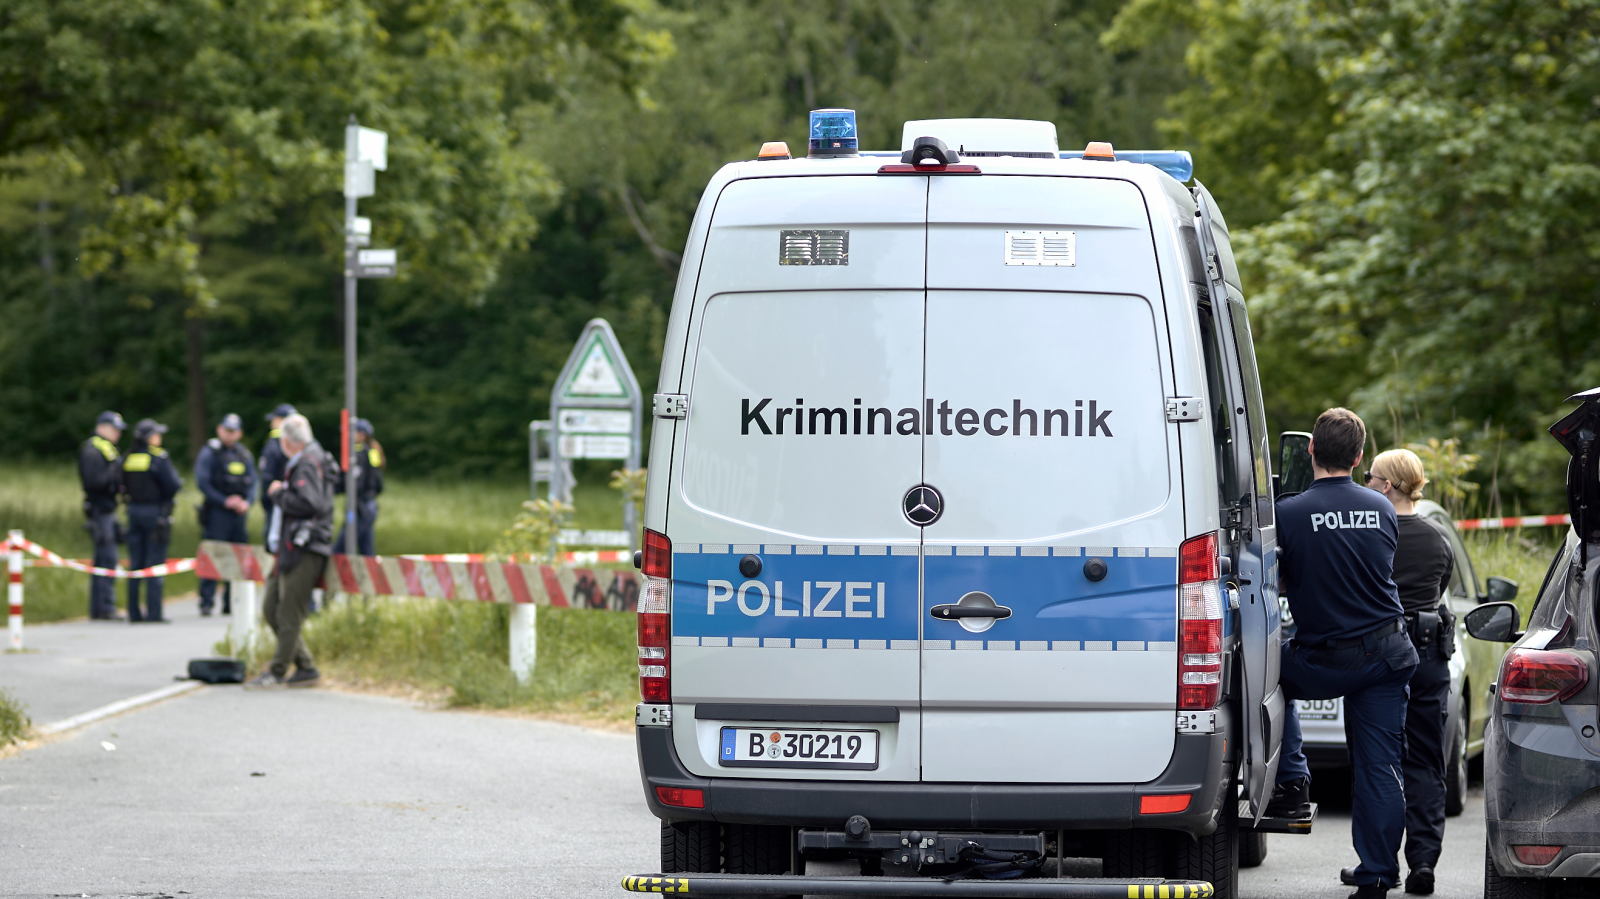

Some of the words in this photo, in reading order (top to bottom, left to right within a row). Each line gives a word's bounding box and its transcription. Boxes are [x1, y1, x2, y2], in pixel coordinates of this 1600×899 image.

[740, 398, 1114, 437] Kriminaltechnik
[1310, 510, 1381, 533] POLIZEI
[706, 579, 886, 618] POLIZEI
[725, 747, 732, 755] D
[749, 733, 765, 757] B
[783, 734, 862, 759] 30219
